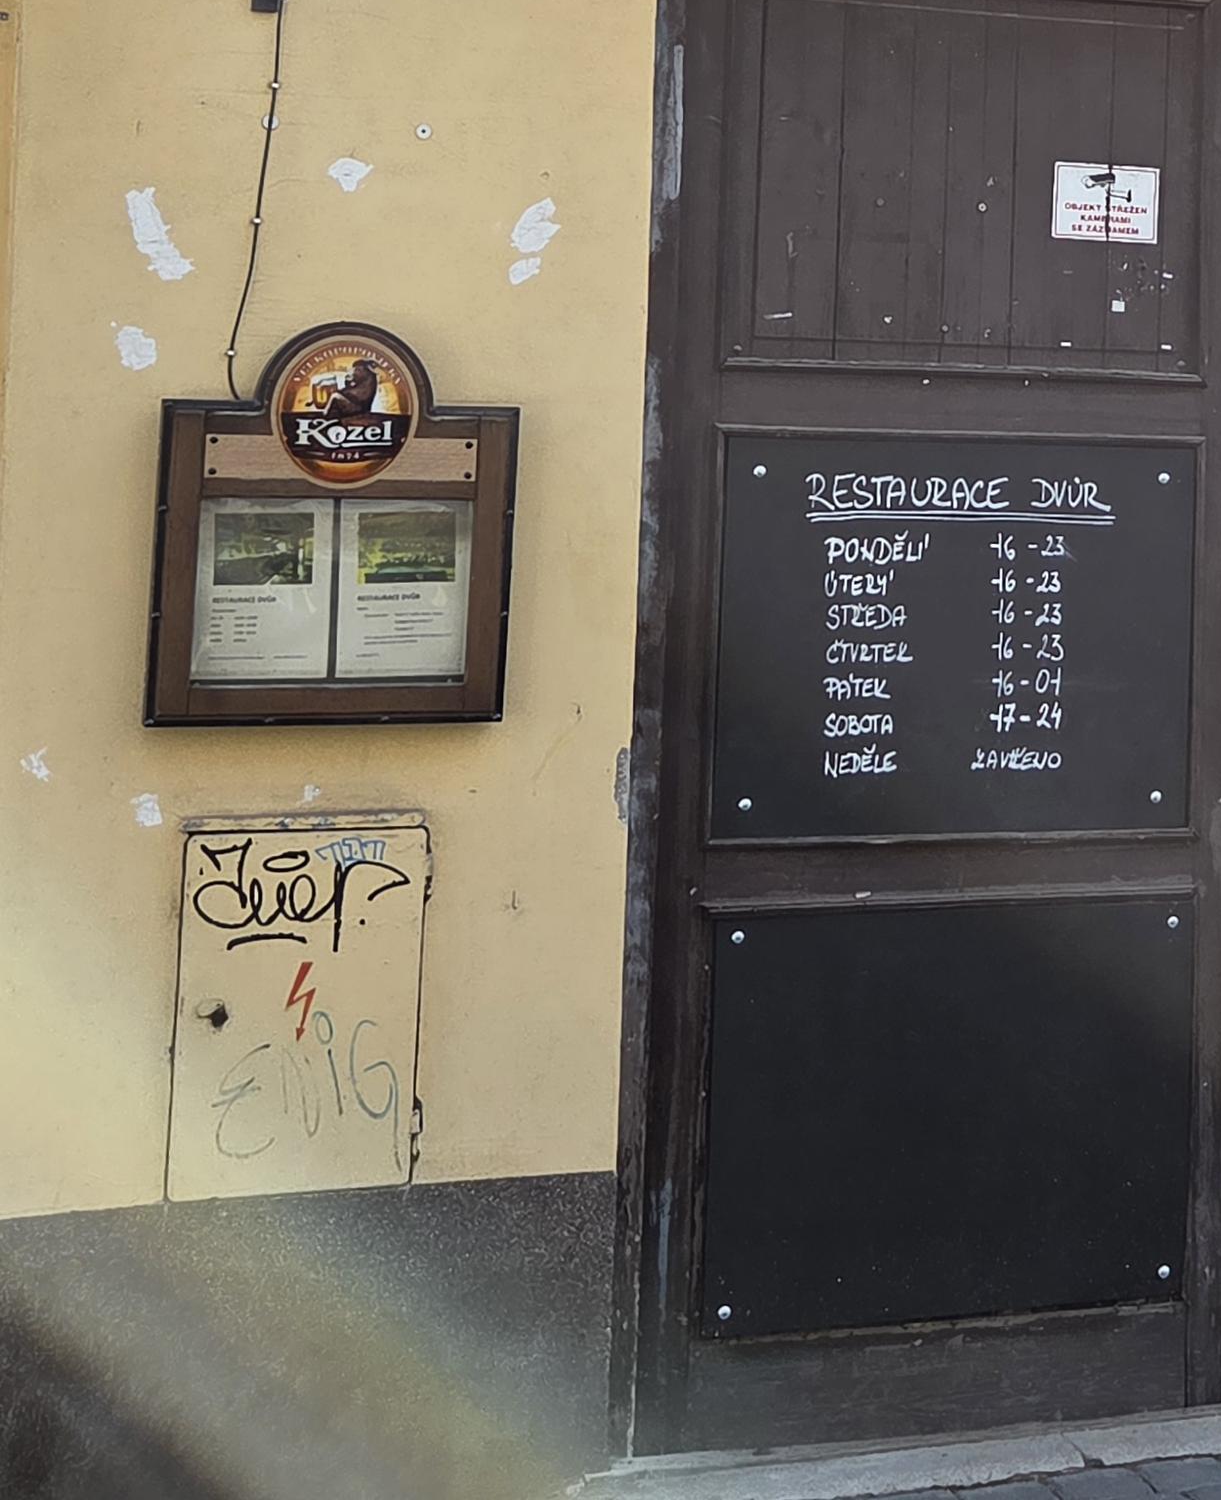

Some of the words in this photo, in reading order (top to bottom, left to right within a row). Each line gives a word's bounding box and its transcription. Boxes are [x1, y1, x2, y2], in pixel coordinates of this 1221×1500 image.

[1064, 202, 1101, 211] OBJEKT
[1071, 224, 1083, 232] SE
[1086, 225, 1139, 235] ZÁZAMEM
[294, 418, 393, 449] Kozel
[805, 473, 1010, 510] RESTAURACE
[1030, 476, 1112, 513] DVŮR
[825, 603, 908, 631] STŘEDA
[825, 638, 914, 664] ČTVRTEK
[823, 712, 894, 738] SOBOTA
[823, 743, 898, 778] NEDĚLE
